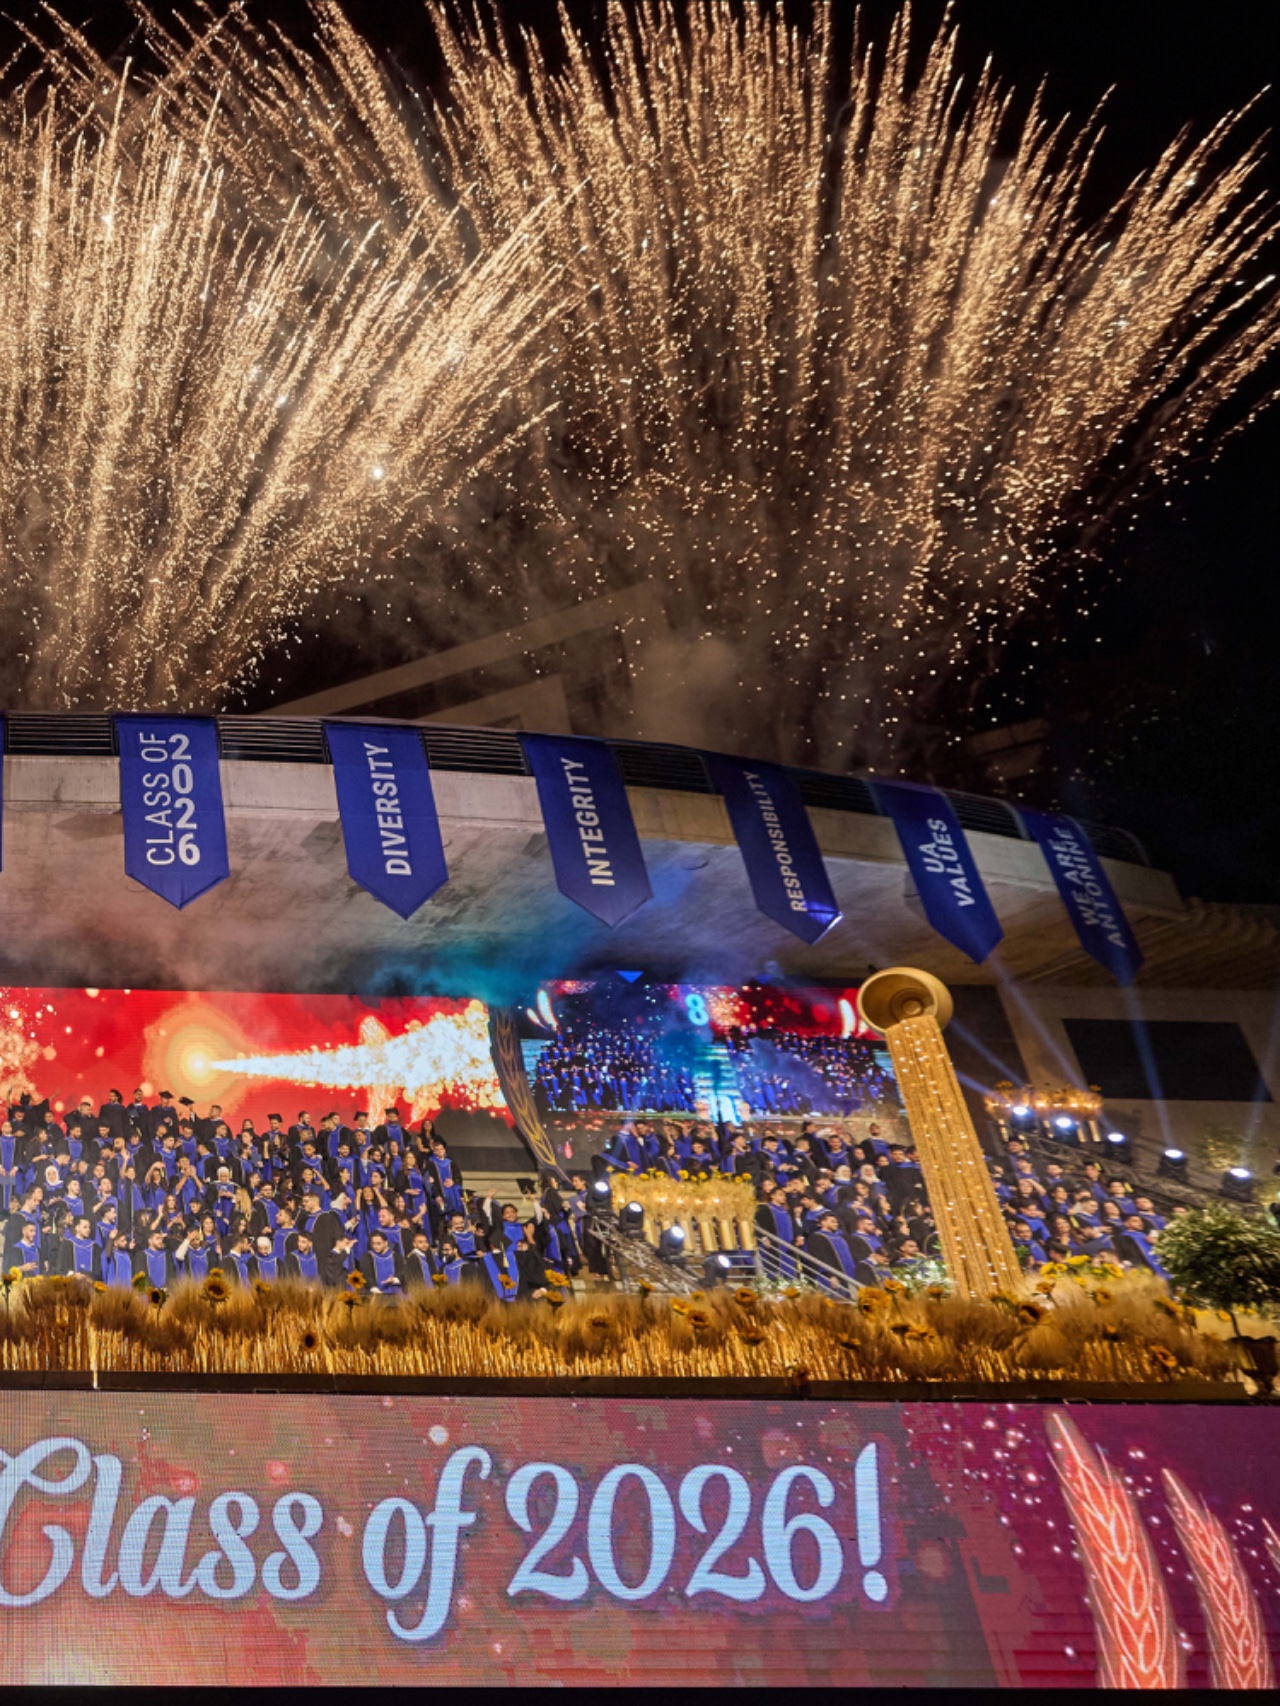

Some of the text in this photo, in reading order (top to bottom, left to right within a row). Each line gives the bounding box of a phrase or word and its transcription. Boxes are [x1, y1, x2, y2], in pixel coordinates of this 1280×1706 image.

[139, 731, 175, 866] CLASS OF
[168, 733, 200, 866] 2026
[364, 742, 412, 876] DIVERSITY
[561, 758, 615, 886] INTEGRITY
[742, 770, 808, 912] RESPONSIBILITY
[919, 841, 945, 872] UA
[928, 818, 975, 907] VALUES
[1048, 839, 1100, 926] WE ARE
[1053, 826, 1127, 948] ANTONINE
[685, 993, 709, 1026] 8
[362, 1446, 492, 1640] of
[505, 1443, 890, 1603] 2026!
